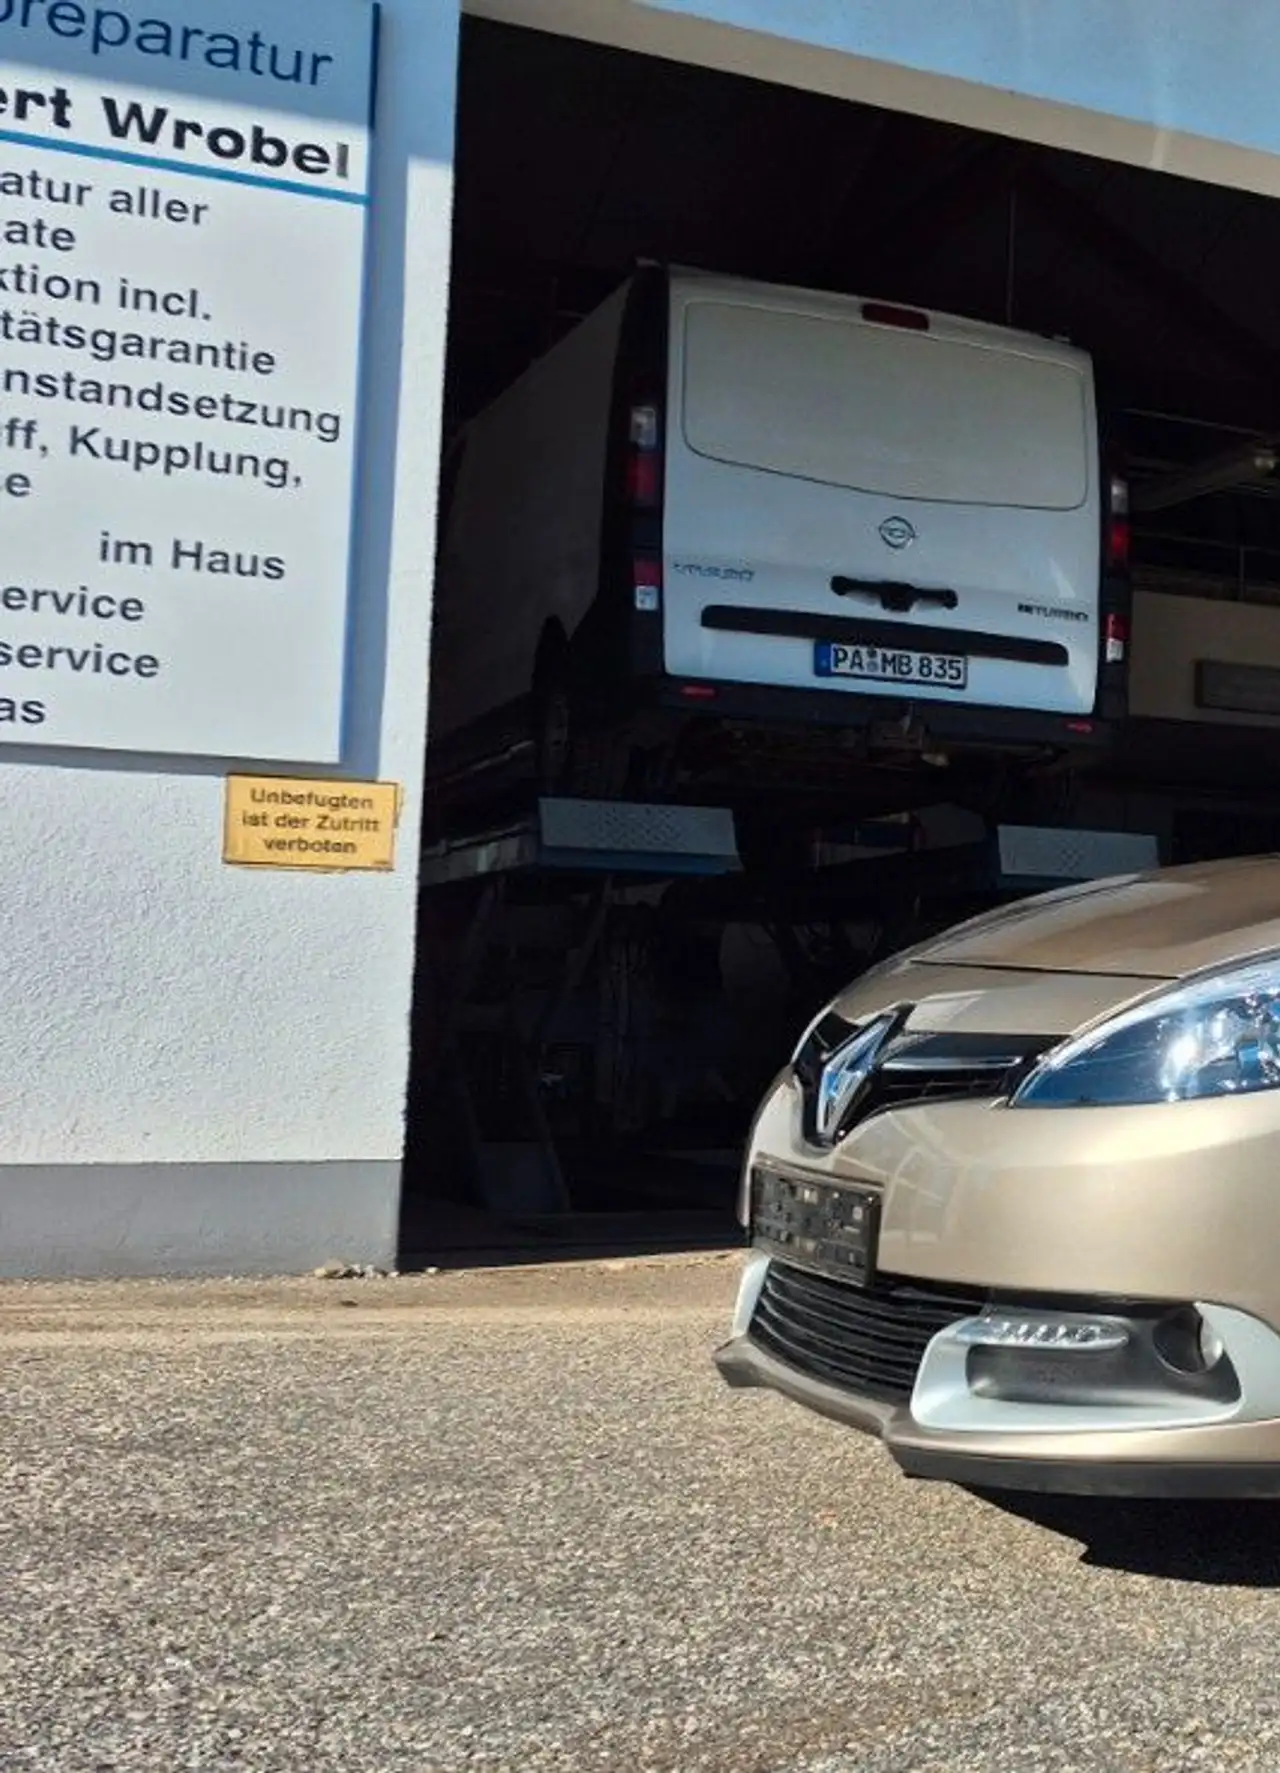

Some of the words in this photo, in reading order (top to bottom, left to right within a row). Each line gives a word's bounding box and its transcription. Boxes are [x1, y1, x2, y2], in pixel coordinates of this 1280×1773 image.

[100, 96, 350, 179] Wrobel
[109, 187, 209, 225] aller
[118, 278, 212, 321] incl.
[69, 424, 303, 488] Kupplung,
[99, 531, 153, 566] im
[172, 538, 287, 581] Haus
[833, 647, 864, 672] PA
[881, 653, 913, 676] MB
[918, 656, 962, 681] 835
[250, 787, 374, 811] Unbefugten
[242, 811, 270, 827] ist
[274, 813, 311, 829] der
[316, 814, 381, 832] Zutritt
[264, 836, 359, 854] verboten
